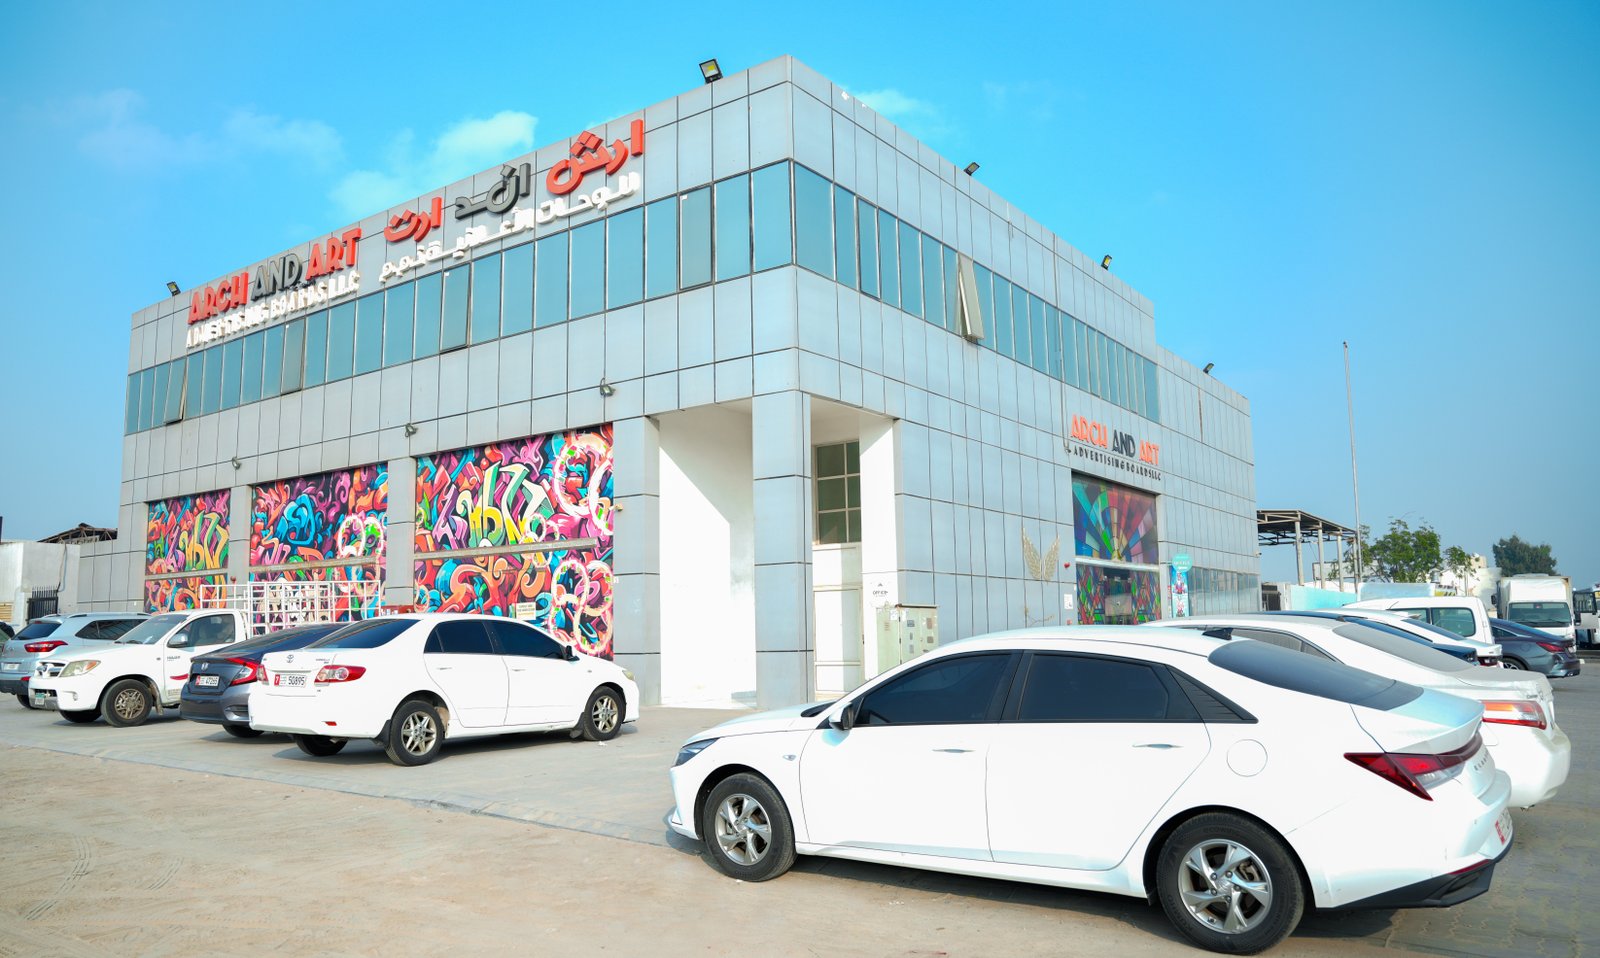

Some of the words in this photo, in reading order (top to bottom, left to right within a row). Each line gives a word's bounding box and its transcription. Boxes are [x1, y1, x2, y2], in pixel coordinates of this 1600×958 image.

[384, 197, 443, 243] ارت
[187, 271, 249, 325] ARCH
[251, 253, 303, 300] AND
[305, 227, 362, 281] ART
[269, 281, 328, 320] BOARDS
[328, 269, 361, 300] LLC
[1070, 413, 1108, 450] ARCH
[1112, 428, 1136, 458] AND
[1139, 439, 1160, 466] ART
